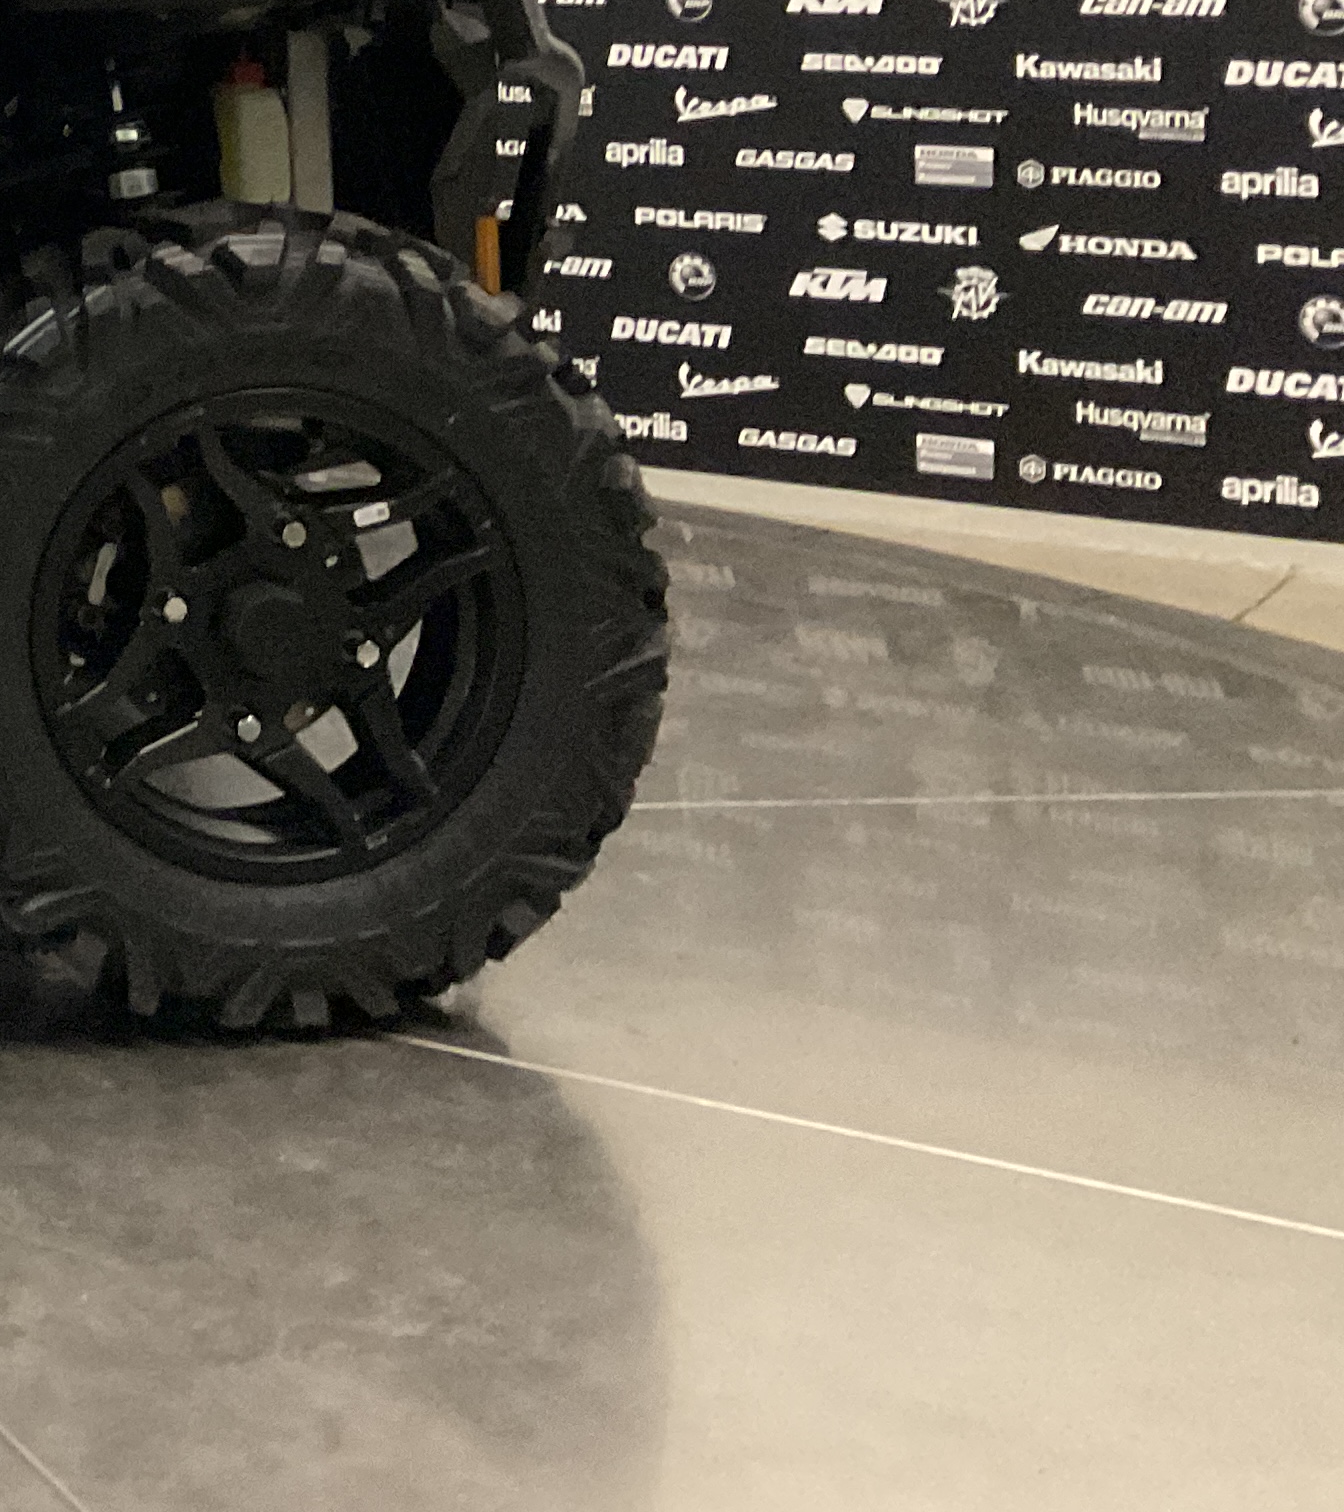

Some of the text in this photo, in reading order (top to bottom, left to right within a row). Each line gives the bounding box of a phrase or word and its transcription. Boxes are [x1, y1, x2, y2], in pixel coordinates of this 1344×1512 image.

[608, 44, 728, 70] DUCATI
[1016, 54, 1161, 81] Kawasaki
[1225, 60, 1344, 88] DUCA
[675, 86, 777, 122] Vespa
[1073, 103, 1206, 134] Husqvarna
[606, 138, 684, 167] aprilia
[736, 149, 854, 171] GASGAS
[1052, 167, 1161, 188] PIAGGIO
[1221, 167, 1318, 200] aprilia
[635, 207, 766, 233] POLARIS
[854, 220, 977, 246] SUZUKI
[1059, 235, 1196, 260] HONDA
[789, 268, 887, 302] KTM
[611, 317, 732, 348] DUCATI
[679, 362, 779, 397] Vespa
[1019, 350, 1163, 384] Kawasaki
[1226, 367, 1344, 401] DUCA
[1075, 401, 1207, 434] Husqvarna
[738, 428, 856, 456] GASGAS
[1054, 463, 1162, 490] PIAGGIO
[1221, 475, 1319, 507] aprilia
